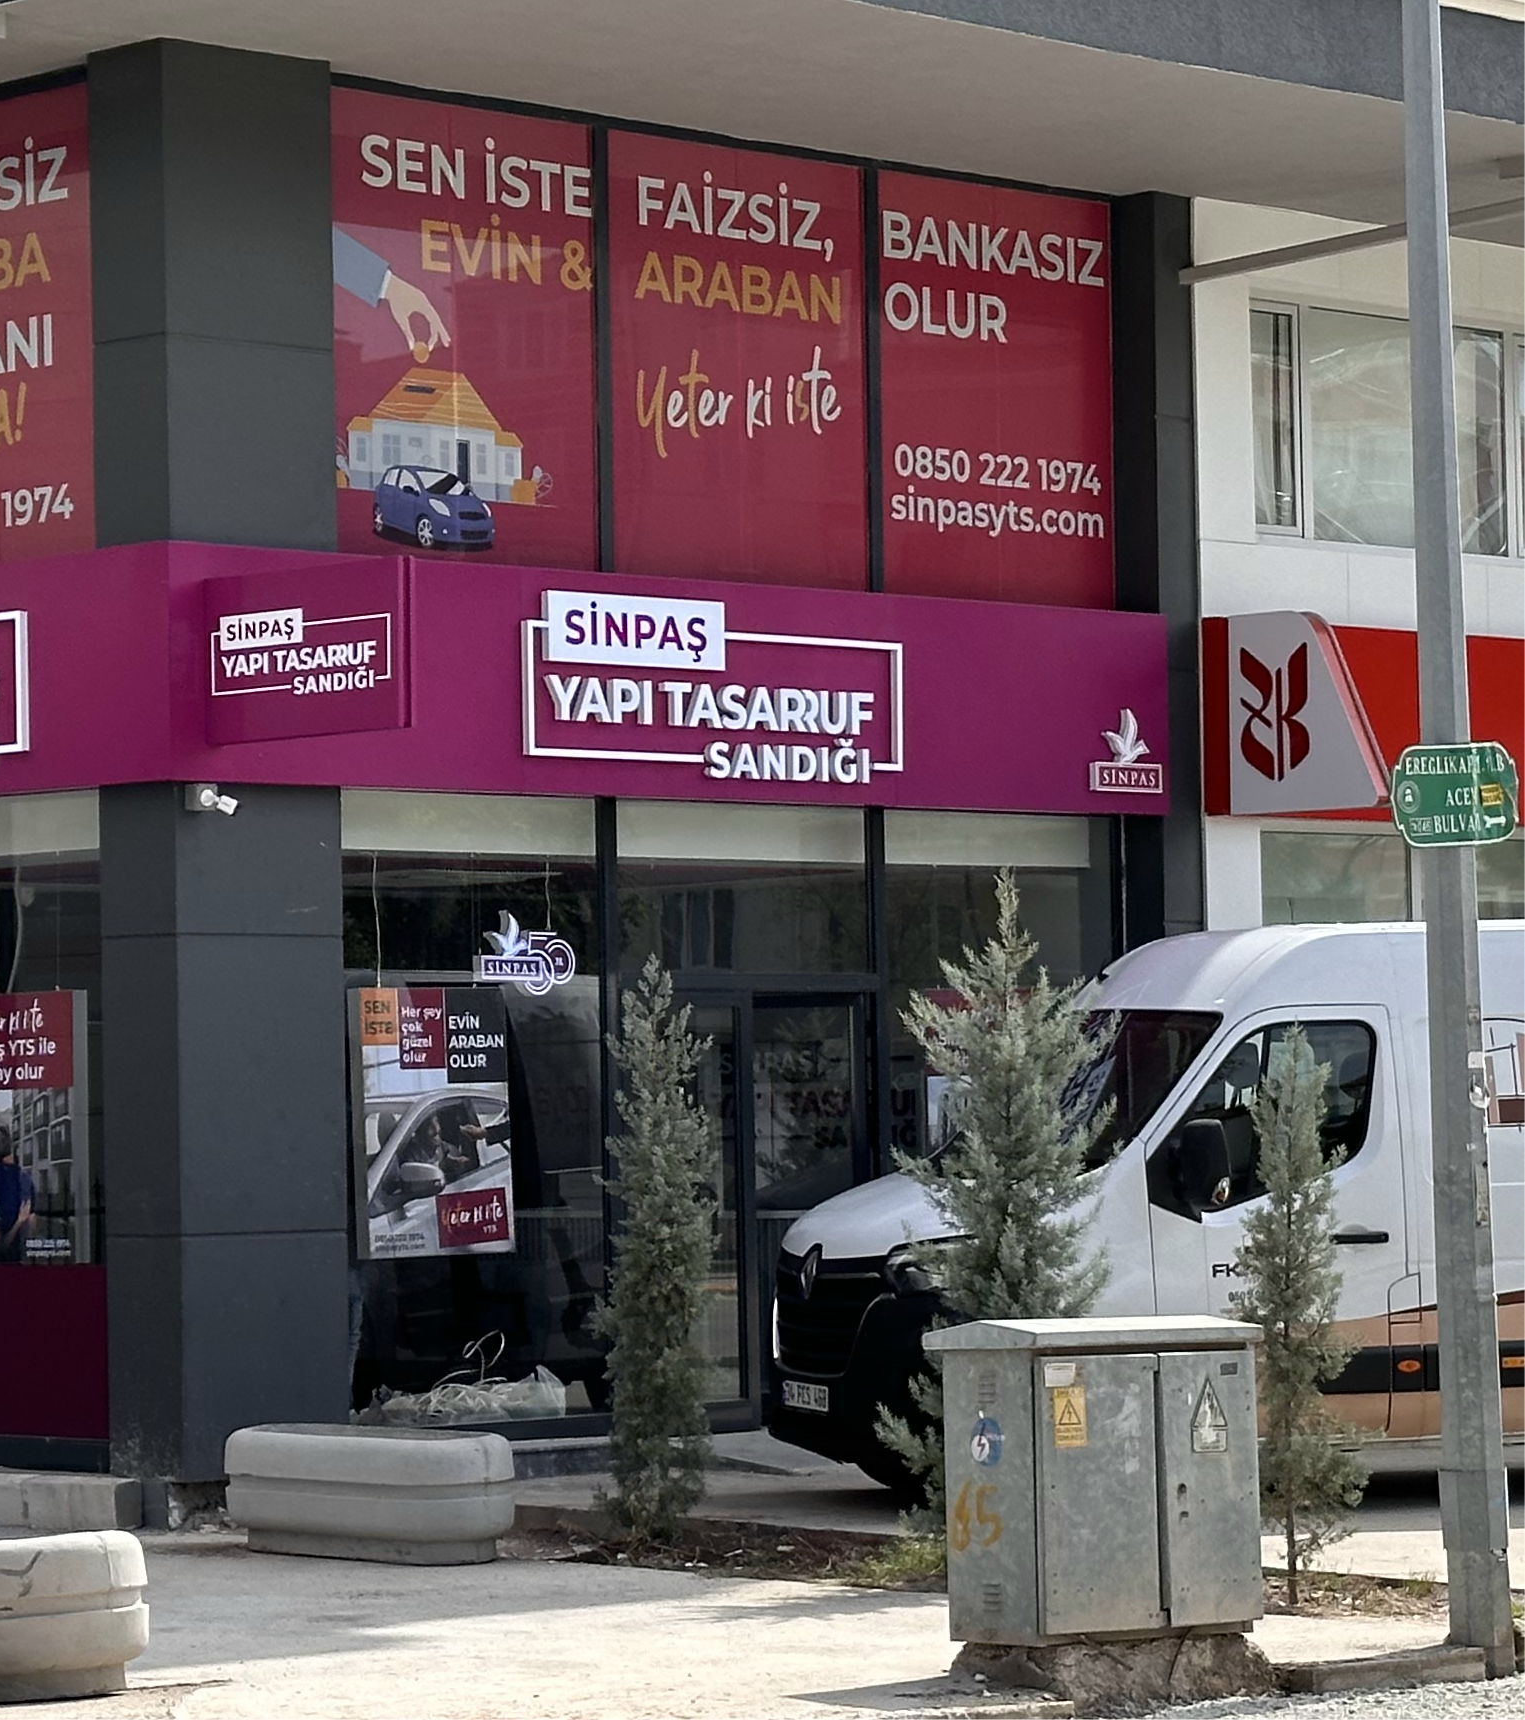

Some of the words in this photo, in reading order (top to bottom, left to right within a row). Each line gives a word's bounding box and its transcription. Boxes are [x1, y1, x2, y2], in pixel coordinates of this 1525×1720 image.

[360, 134, 465, 200] SEN
[485, 136, 592, 218] İSTE
[638, 171, 834, 262] FAİZSİZ,
[420, 213, 541, 285] EVİN
[561, 240, 592, 291] &
[883, 210, 1105, 288] BANKASIZ
[635, 252, 841, 324] ARABAN
[885, 282, 1008, 343] OLUR
[894, 444, 971, 482] 0850
[979, 453, 1030, 489] 222
[1037, 459, 1101, 496] 1974
[1, 483, 74, 528] 1974
[890, 486, 1105, 539] sinpasyts.com
[224, 614, 295, 642] SİNPAŞ
[565, 601, 708, 661] SİNPAŞ
[221, 649, 269, 679] YAPI
[272, 640, 376, 674] TASARRUF
[292, 666, 374, 696] SANDIĞI
[544, 674, 654, 726] YAPI
[661, 681, 874, 735] TASARRUF
[705, 737, 871, 784] SANDIĞI
[364, 1001, 390, 1014] SEN
[401, 1007, 421, 1018] Her
[448, 1011, 480, 1030] EVİN
[8, 1039, 35, 1056] YTS
[39, 1037, 56, 1055] ile
[402, 1035, 432, 1050] güzel
[403, 1051, 426, 1063] olur
[448, 1034, 504, 1049] ARABAN
[450, 1054, 487, 1068] OLUR
[16, 1063, 44, 1080] olur
